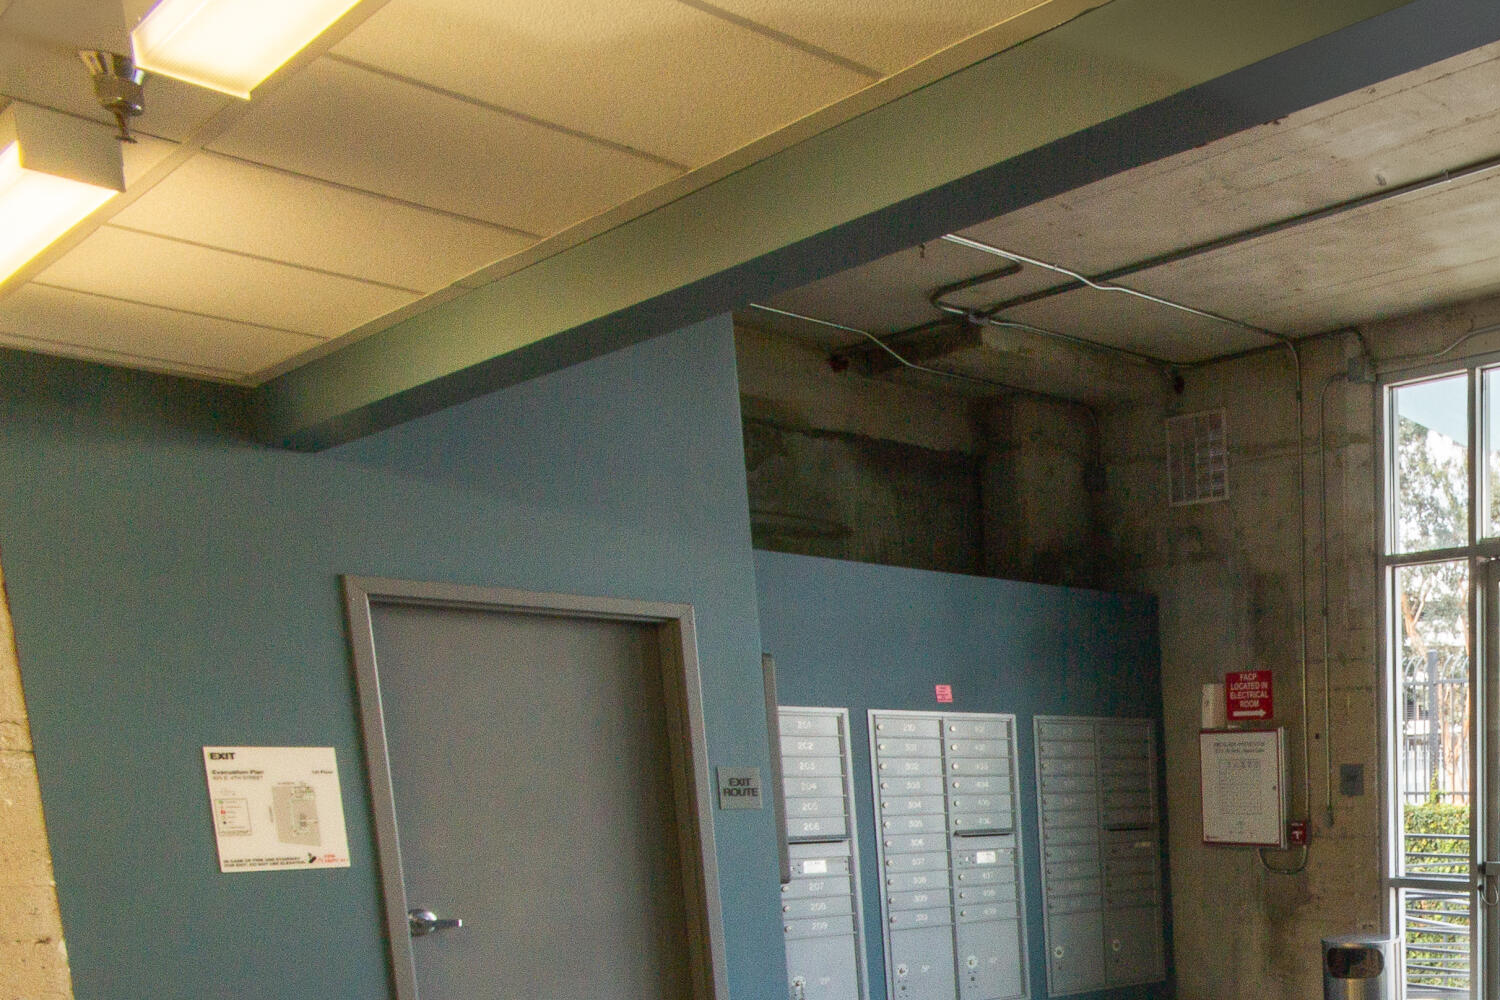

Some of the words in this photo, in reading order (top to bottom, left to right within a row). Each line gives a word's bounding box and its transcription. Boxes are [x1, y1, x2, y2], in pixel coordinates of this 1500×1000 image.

[1240, 673, 1257, 681] FACP
[1230, 682, 1260, 691] LOCATED
[1260, 681, 1268, 689] IN
[1230, 690, 1268, 700] ELECTRICAL
[1240, 700, 1260, 708] ROOM
[798, 741, 814, 750] 202
[210, 752, 235, 760] EXIT
[799, 762, 816, 770] 203
[728, 778, 752, 786] EXIT
[723, 788, 759, 796] ROUTE
[803, 822, 820, 832] 206
